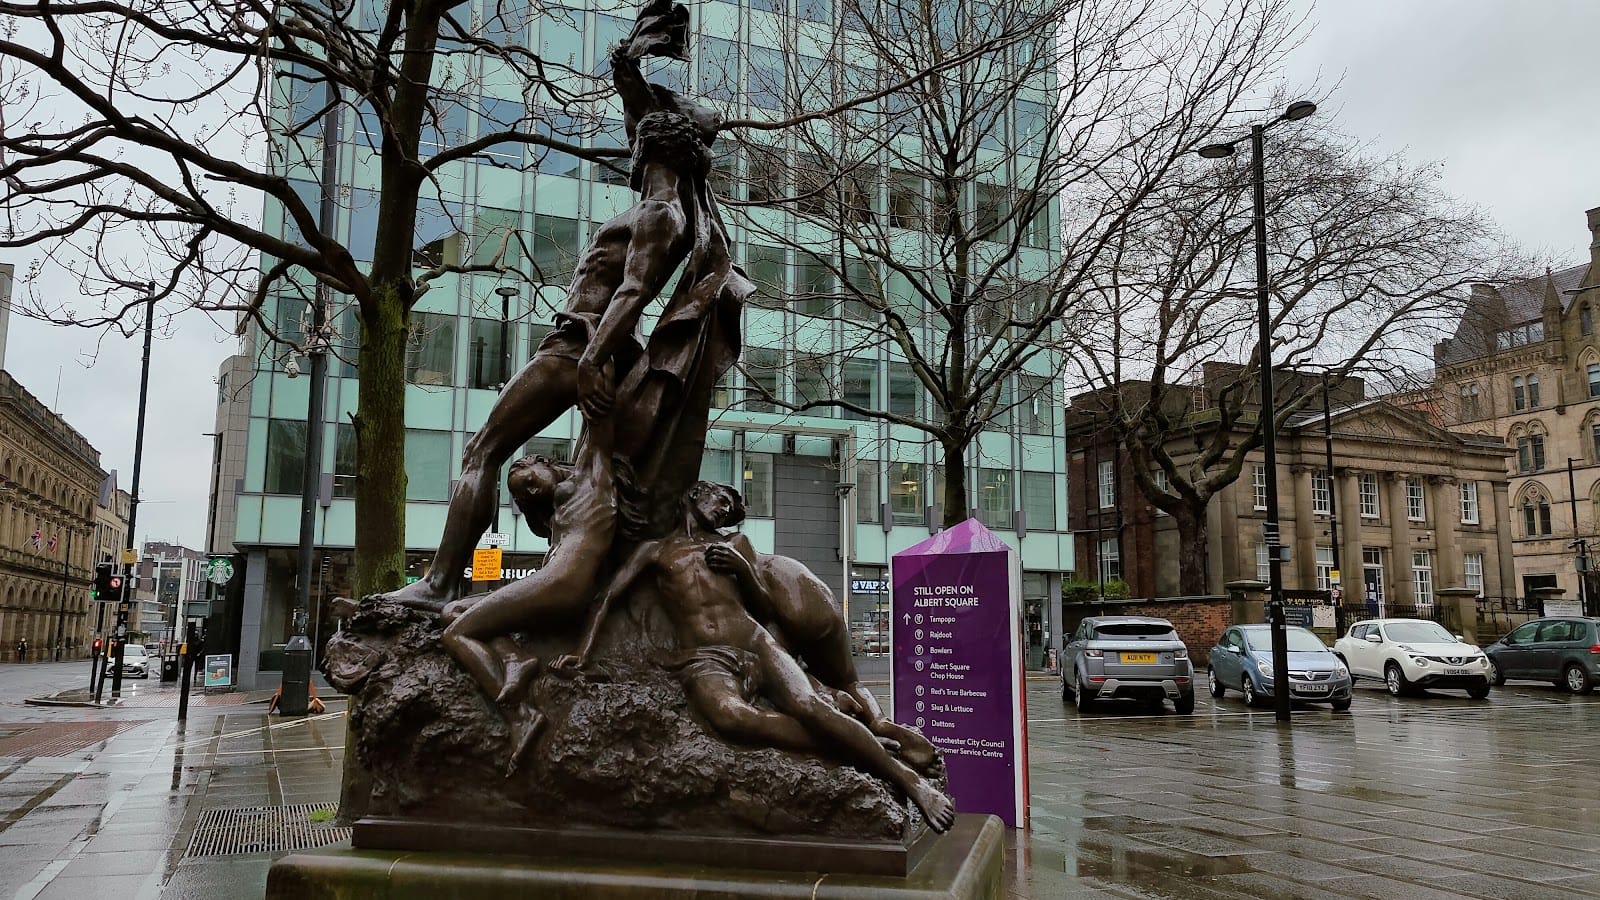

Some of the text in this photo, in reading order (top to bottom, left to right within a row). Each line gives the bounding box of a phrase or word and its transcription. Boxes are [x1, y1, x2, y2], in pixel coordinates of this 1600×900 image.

[914, 585, 974, 596] STILL OPEN ON
[914, 597, 979, 609] ALBERT SQUARE
[929, 631, 953, 640] Rajdoot
[929, 662, 971, 673] Albert Square
[930, 671, 965, 681] Chop House
[930, 687, 987, 698] Red's True Barbecue
[931, 703, 974, 713] Slug & Lettuce
[931, 735, 1005, 749] Manchester City Council
[959, 747, 982, 757] Service
[982, 749, 1004, 758] Centre
